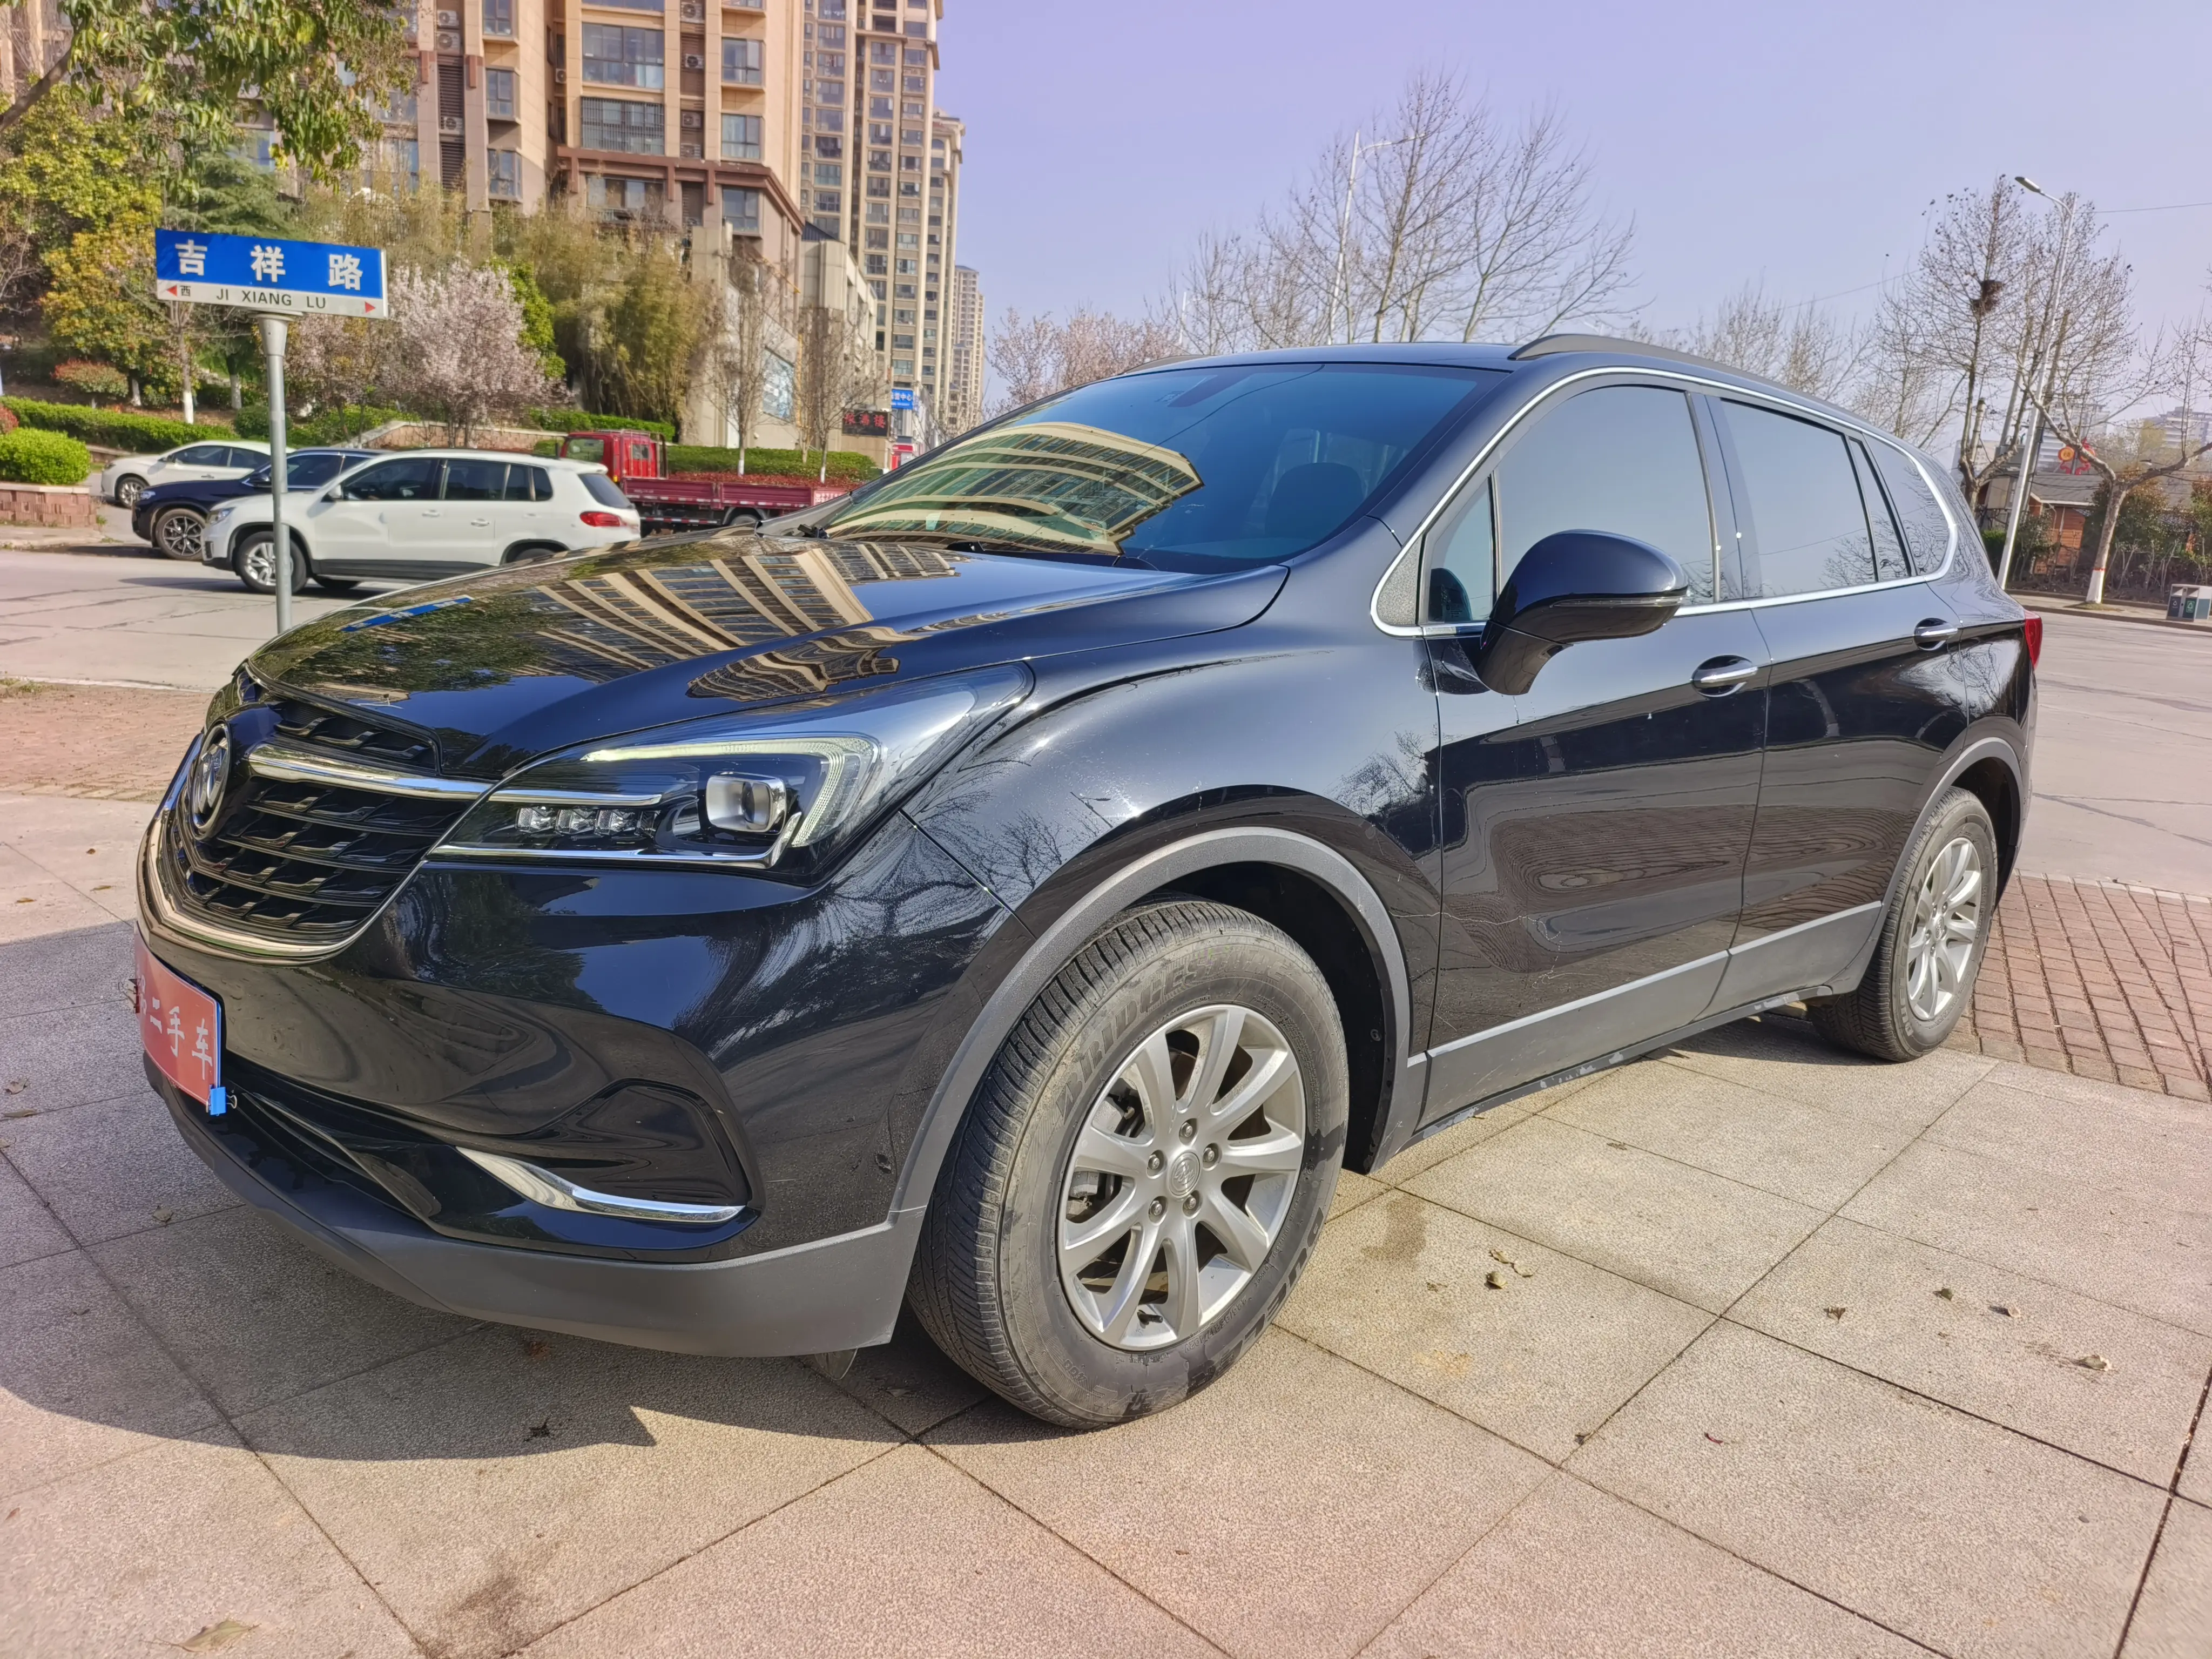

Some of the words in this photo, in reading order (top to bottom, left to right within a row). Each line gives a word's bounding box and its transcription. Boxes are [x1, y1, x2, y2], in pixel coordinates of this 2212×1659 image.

[175, 239, 363, 291] 吉祥路
[180, 285, 191, 297] 西
[217, 288, 229, 301] JI
[242, 290, 292, 306] XIANG
[306, 297, 326, 309] LU
